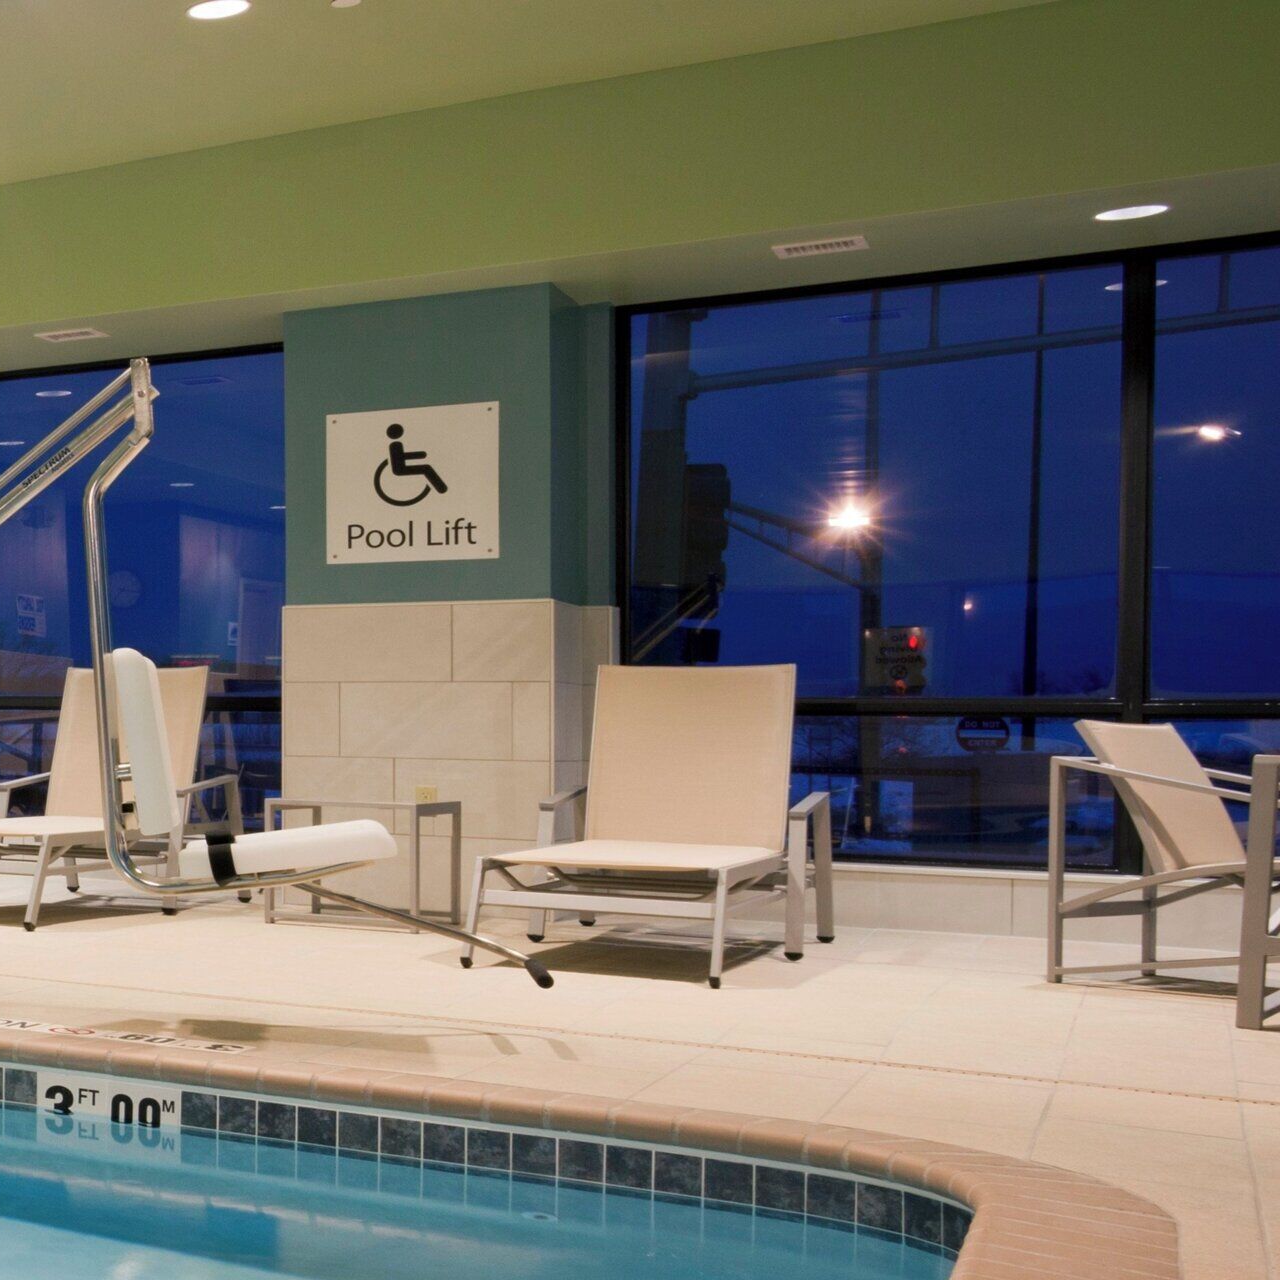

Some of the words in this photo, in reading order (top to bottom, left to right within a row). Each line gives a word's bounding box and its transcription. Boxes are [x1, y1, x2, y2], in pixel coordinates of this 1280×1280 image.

[22, 447, 72, 488] SPECTRUM
[347, 520, 414, 549] Pool
[426, 517, 478, 547] Lift
[45, 1085, 74, 1115] 3
[78, 1088, 100, 1106] FT
[162, 1099, 175, 1113] M
